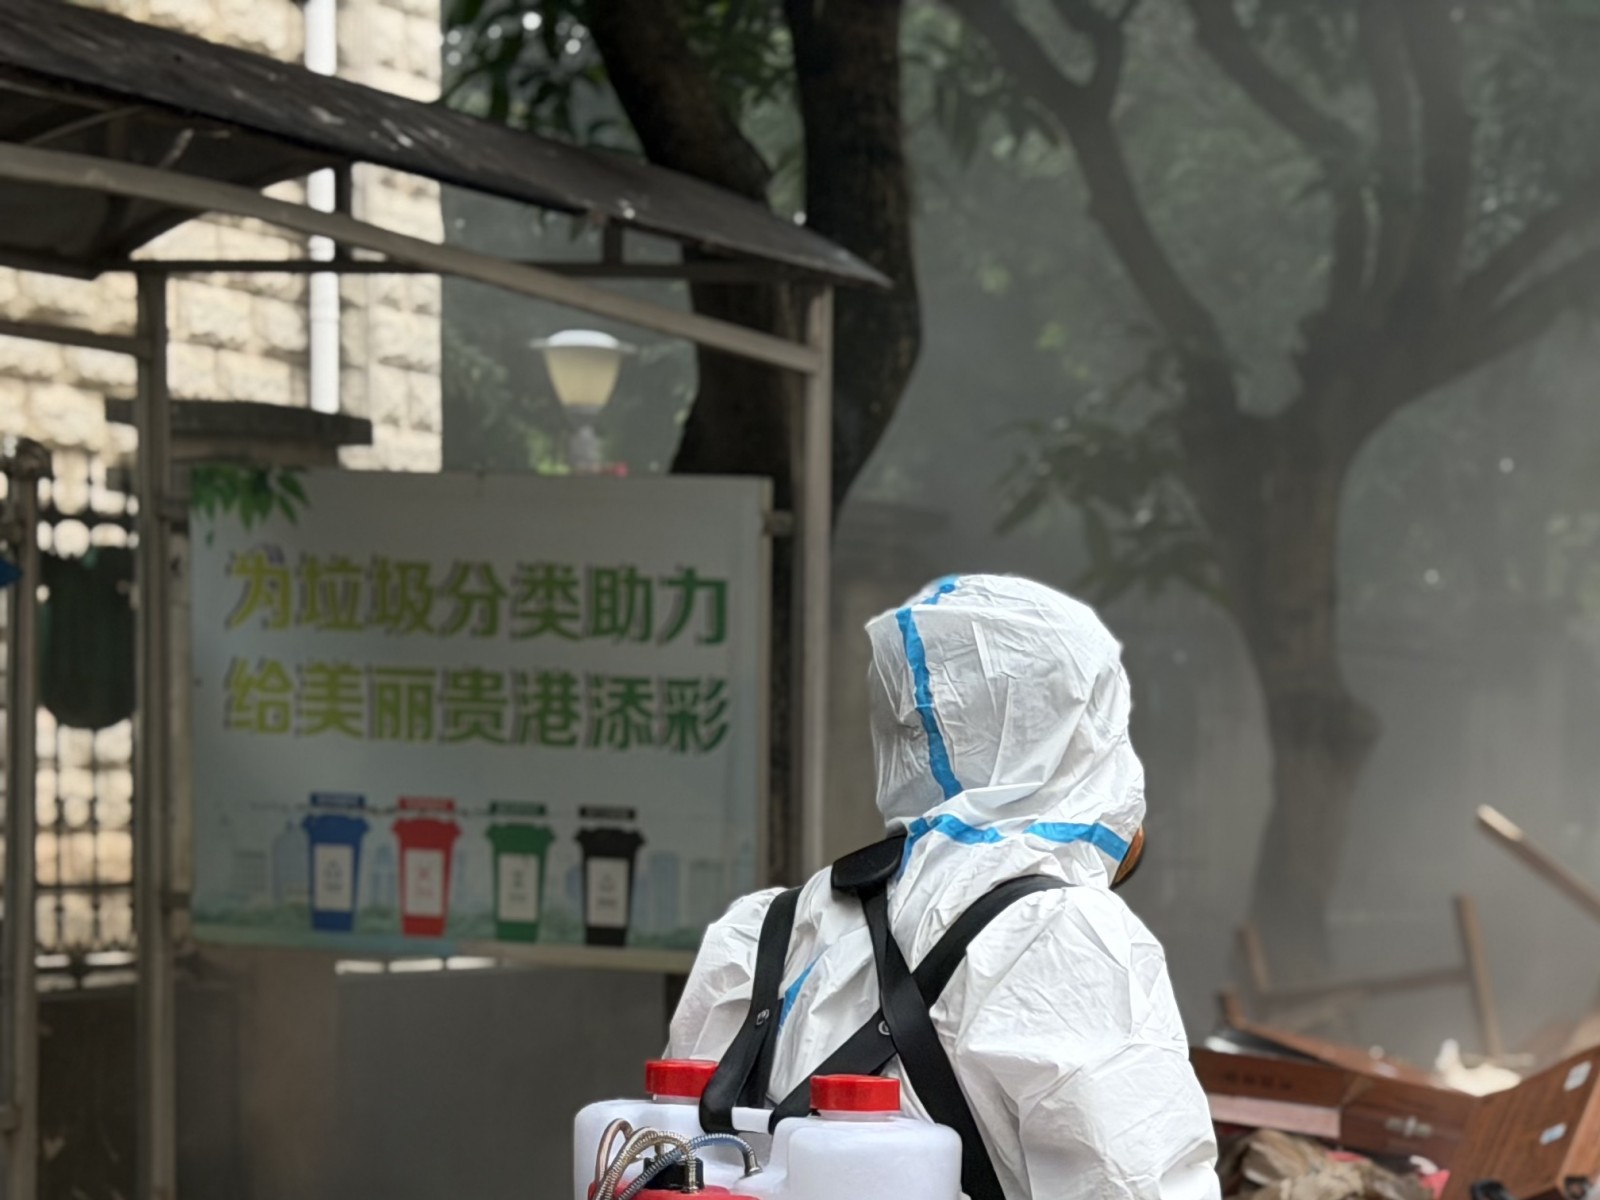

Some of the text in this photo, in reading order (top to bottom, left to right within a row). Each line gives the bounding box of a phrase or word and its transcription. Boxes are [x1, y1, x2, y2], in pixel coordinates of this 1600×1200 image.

[227, 550, 729, 646] 为垃圾分类助力
[226, 657, 730, 754] 给美丽贵港添彩
